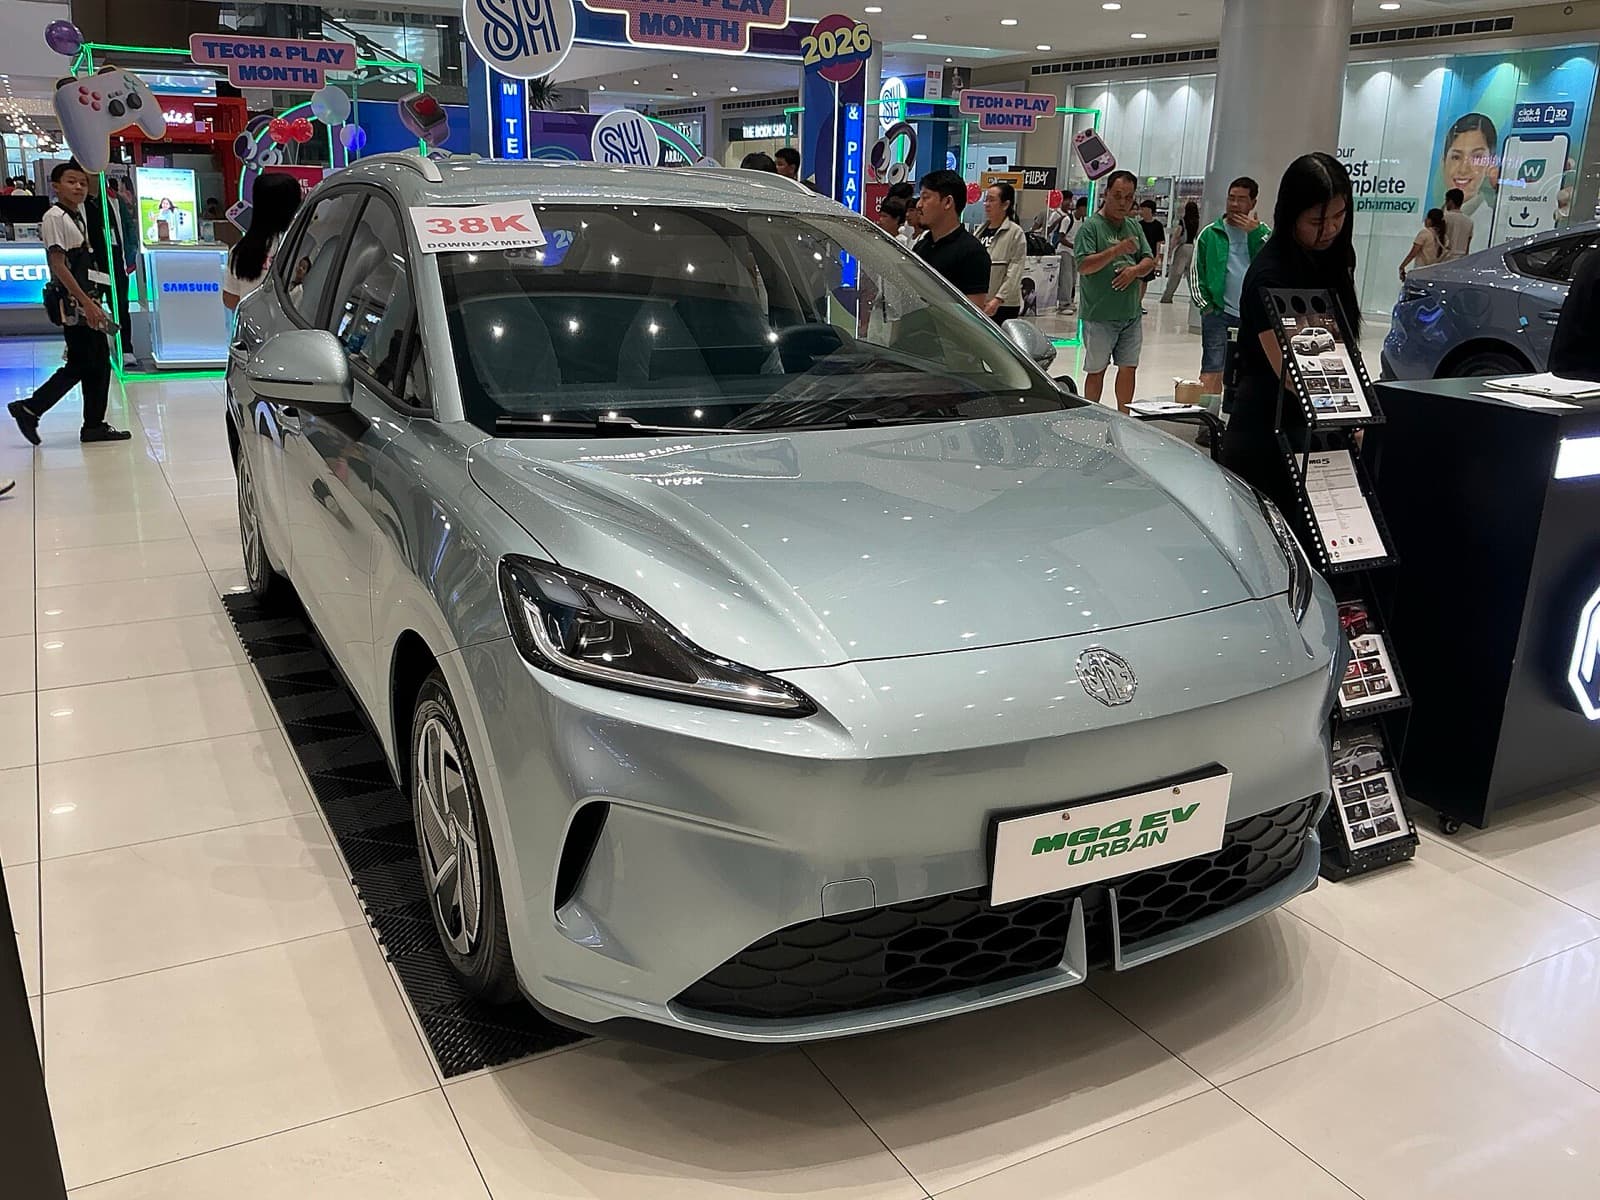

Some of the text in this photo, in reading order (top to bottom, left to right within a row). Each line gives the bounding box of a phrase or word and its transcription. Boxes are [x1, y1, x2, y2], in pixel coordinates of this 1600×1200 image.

[477, 0, 561, 61] SM
[639, 12, 739, 43] MONTH
[202, 42, 345, 65] TECH & PLAY
[800, 24, 871, 66] 2026
[238, 65, 318, 84] MONTH
[967, 95, 1050, 112] TECH & PLAY
[985, 113, 1032, 127] MONTH
[506, 118, 519, 154] TE
[599, 118, 651, 166] SM
[1336, 147, 1356, 159] our
[845, 142, 858, 210] PLAY
[1344, 160, 1369, 177] ost
[1357, 198, 1416, 214] pharmacy
[1508, 194, 1542, 202] download
[425, 214, 532, 235] 38K
[427, 239, 541, 249] DOWNPAYMENT
[0, 264, 50, 282] TECN
[163, 282, 219, 293] SAMSUNG
[1031, 802, 1201, 856] MG4 EV
[1067, 827, 1169, 866] URBAN
